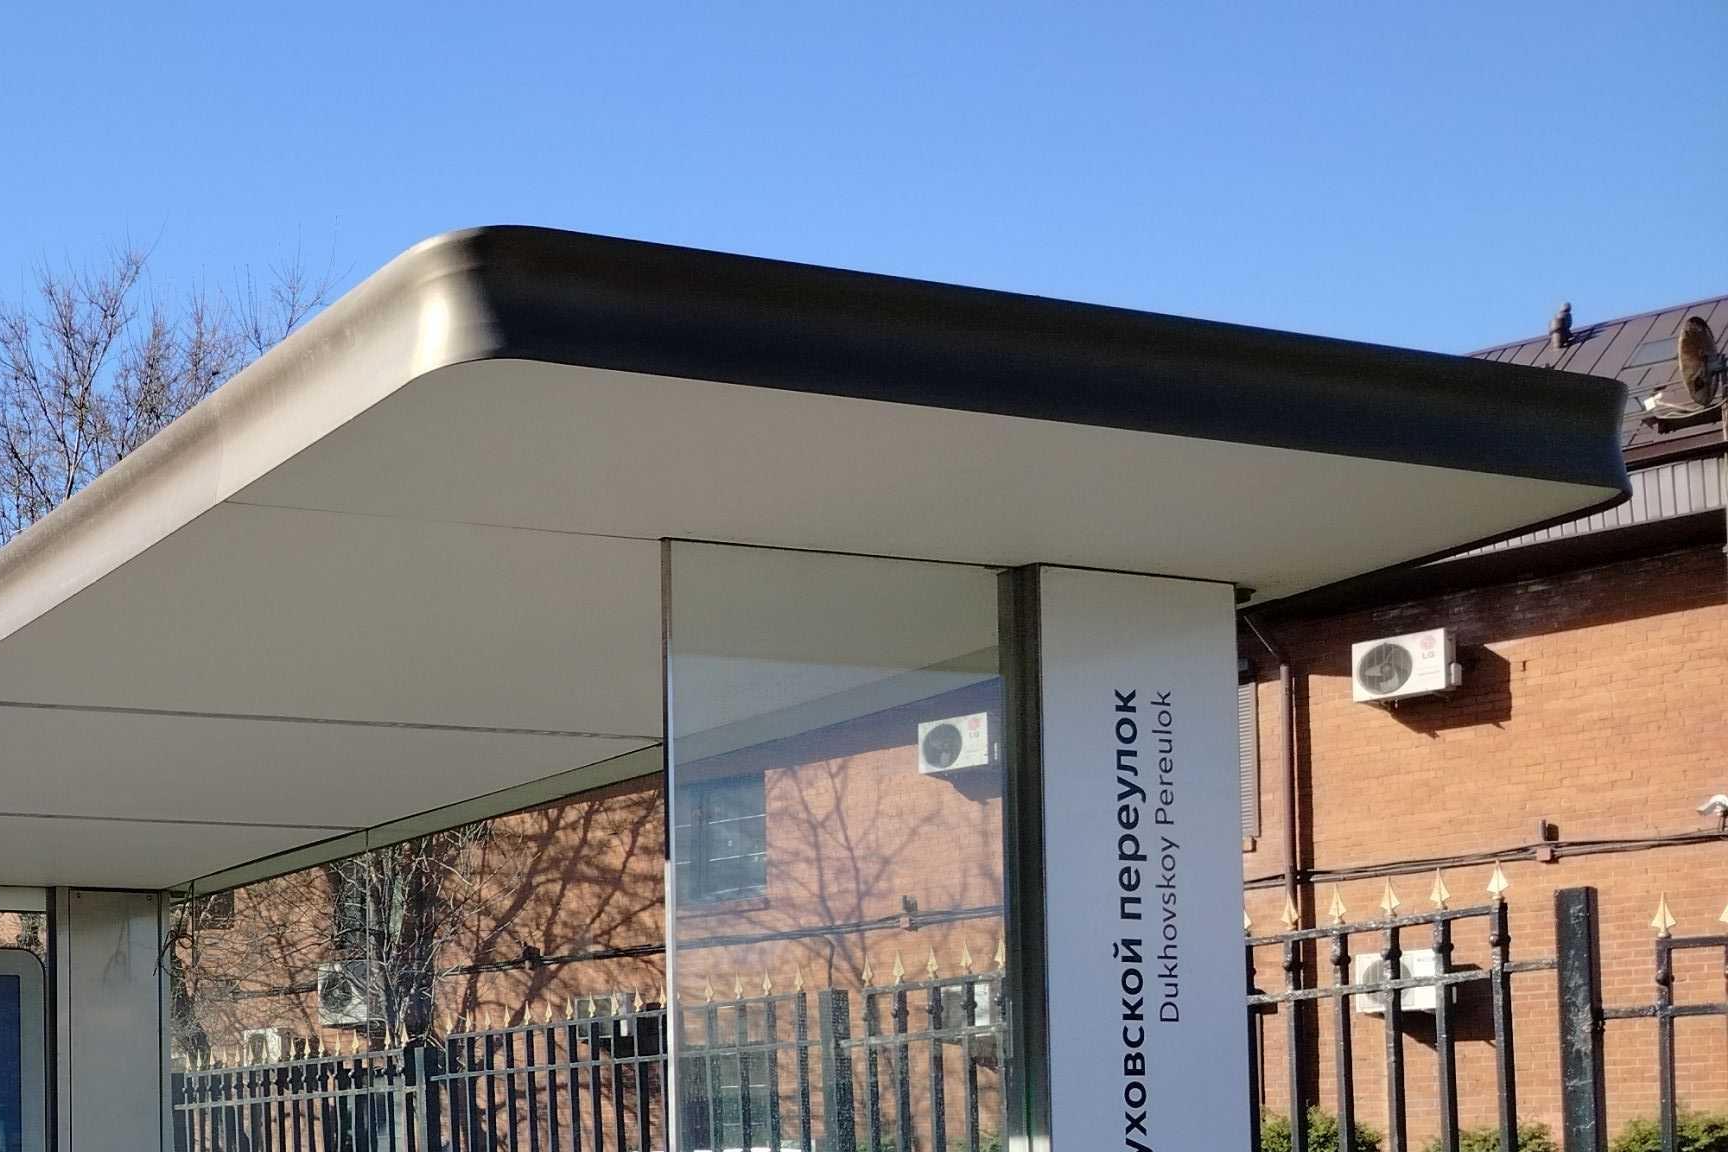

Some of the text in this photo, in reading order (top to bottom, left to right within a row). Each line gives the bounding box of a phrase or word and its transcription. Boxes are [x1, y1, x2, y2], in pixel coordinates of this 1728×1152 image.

[1114, 688, 1147, 921] переулок
[1151, 690, 1181, 1023] Dukhovskoy Pereulok
